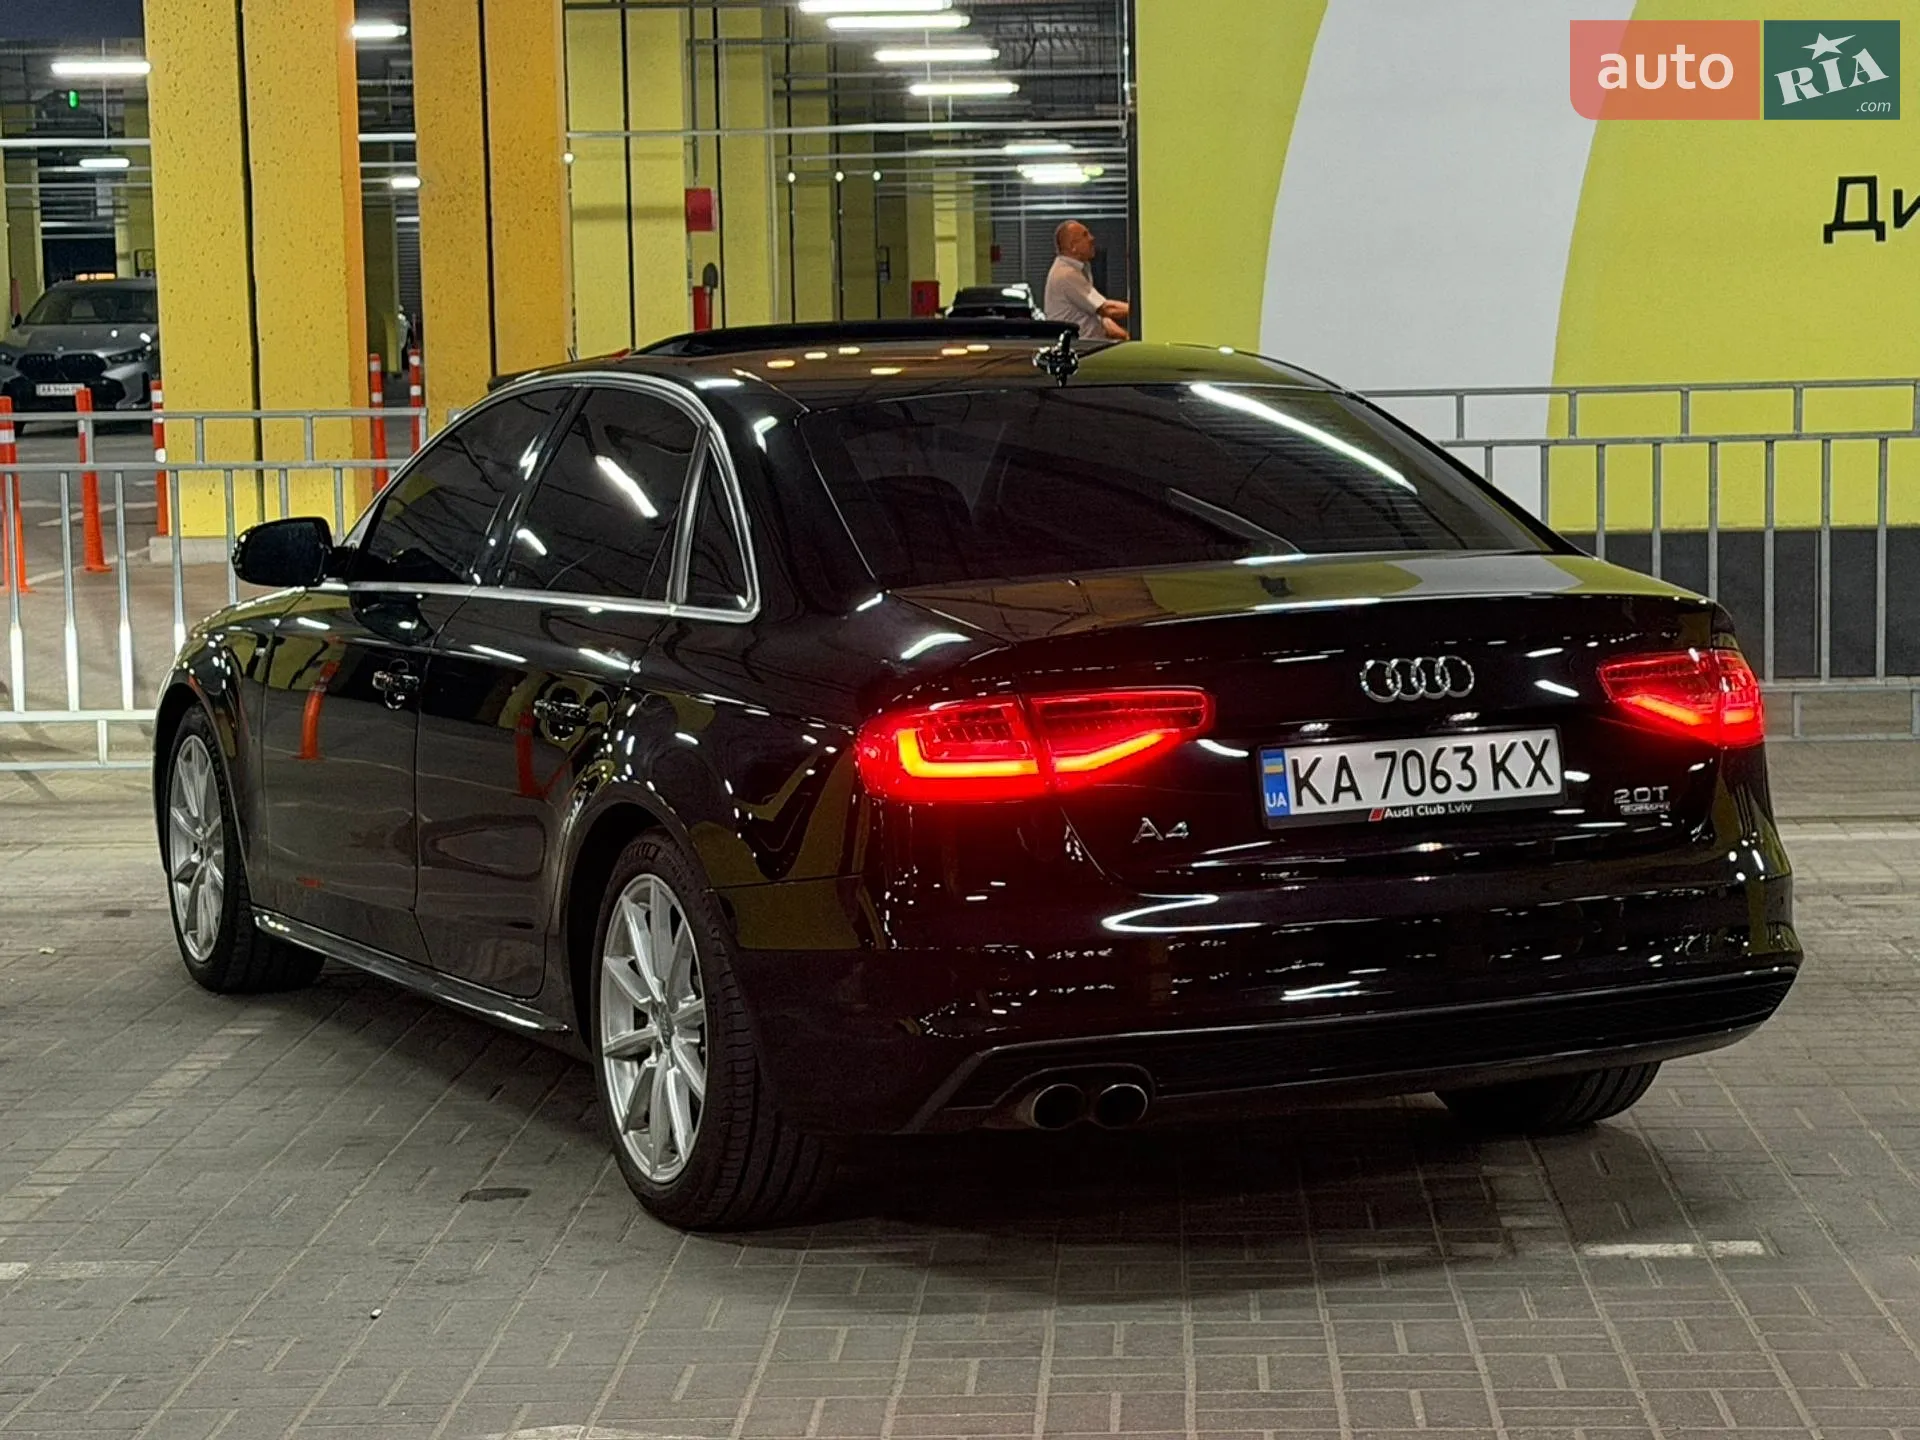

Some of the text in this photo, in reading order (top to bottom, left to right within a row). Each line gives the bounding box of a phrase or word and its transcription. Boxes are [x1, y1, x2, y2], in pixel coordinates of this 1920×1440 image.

[1291, 739, 1554, 807] KA 7063 KX
[1266, 792, 1287, 808] UA
[1384, 802, 1473, 819] Audi Club Lviv
[1132, 817, 1189, 843] A4
